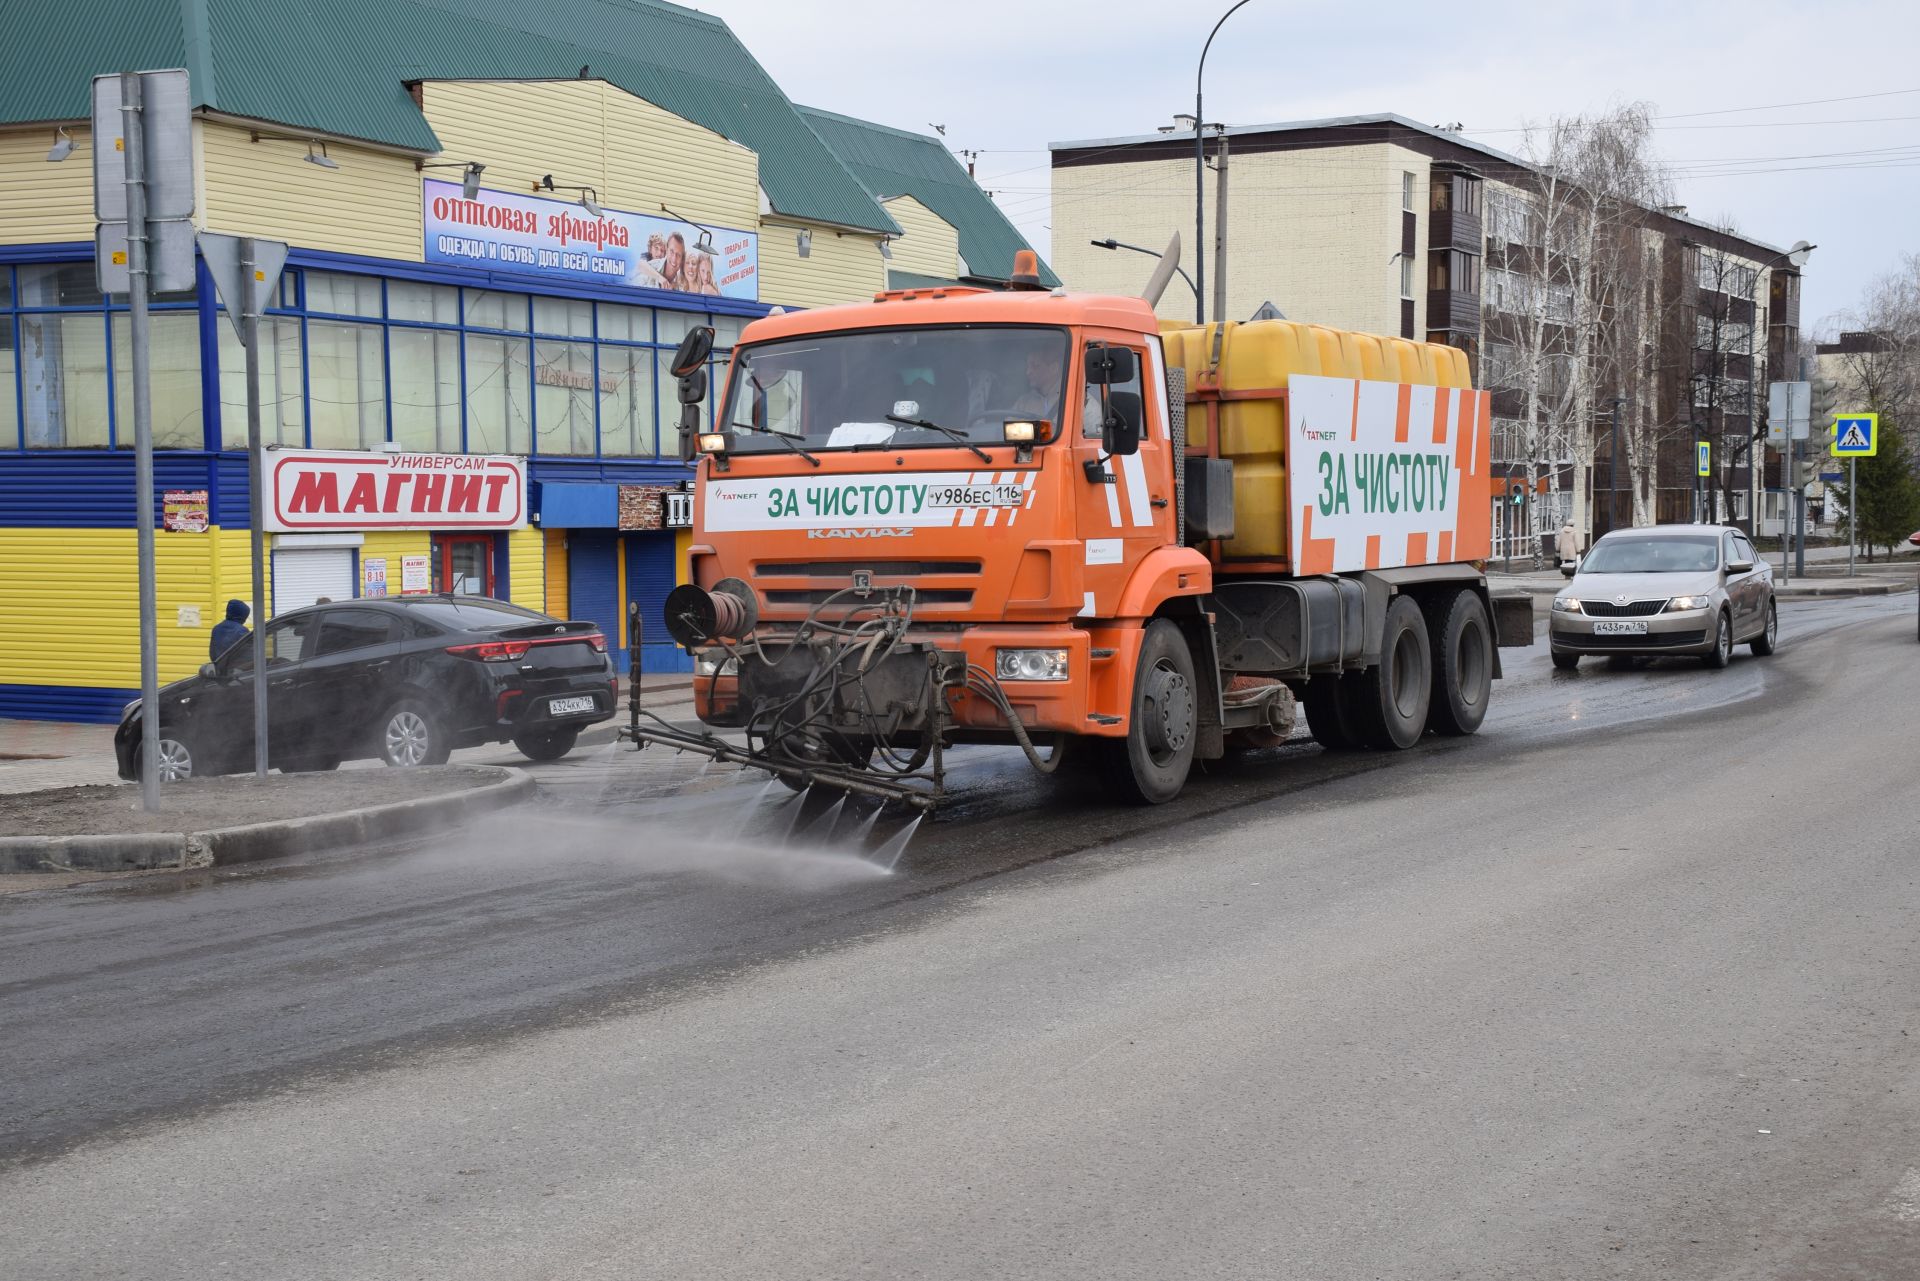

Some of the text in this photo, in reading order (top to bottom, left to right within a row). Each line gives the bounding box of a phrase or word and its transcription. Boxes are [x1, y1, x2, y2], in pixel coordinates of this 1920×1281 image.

[438, 235, 625, 276] ОДЕЖДА И ОБУВЬ ДЛЯ ВСЕЙ СЕМЬИ
[724, 242, 741, 256] ТОВАРЫ
[1307, 431, 1337, 441] TATNEFT
[390, 455, 486, 470] УНИВЕРСАМ
[1318, 451, 1450, 517] ЗА ЧИСТОТУ
[287, 471, 510, 513] МАГНИТ
[995, 486, 1018, 498] 116
[767, 484, 928, 518] ЗА ЧИСТОТУ
[807, 527, 914, 539] KAMAZ
